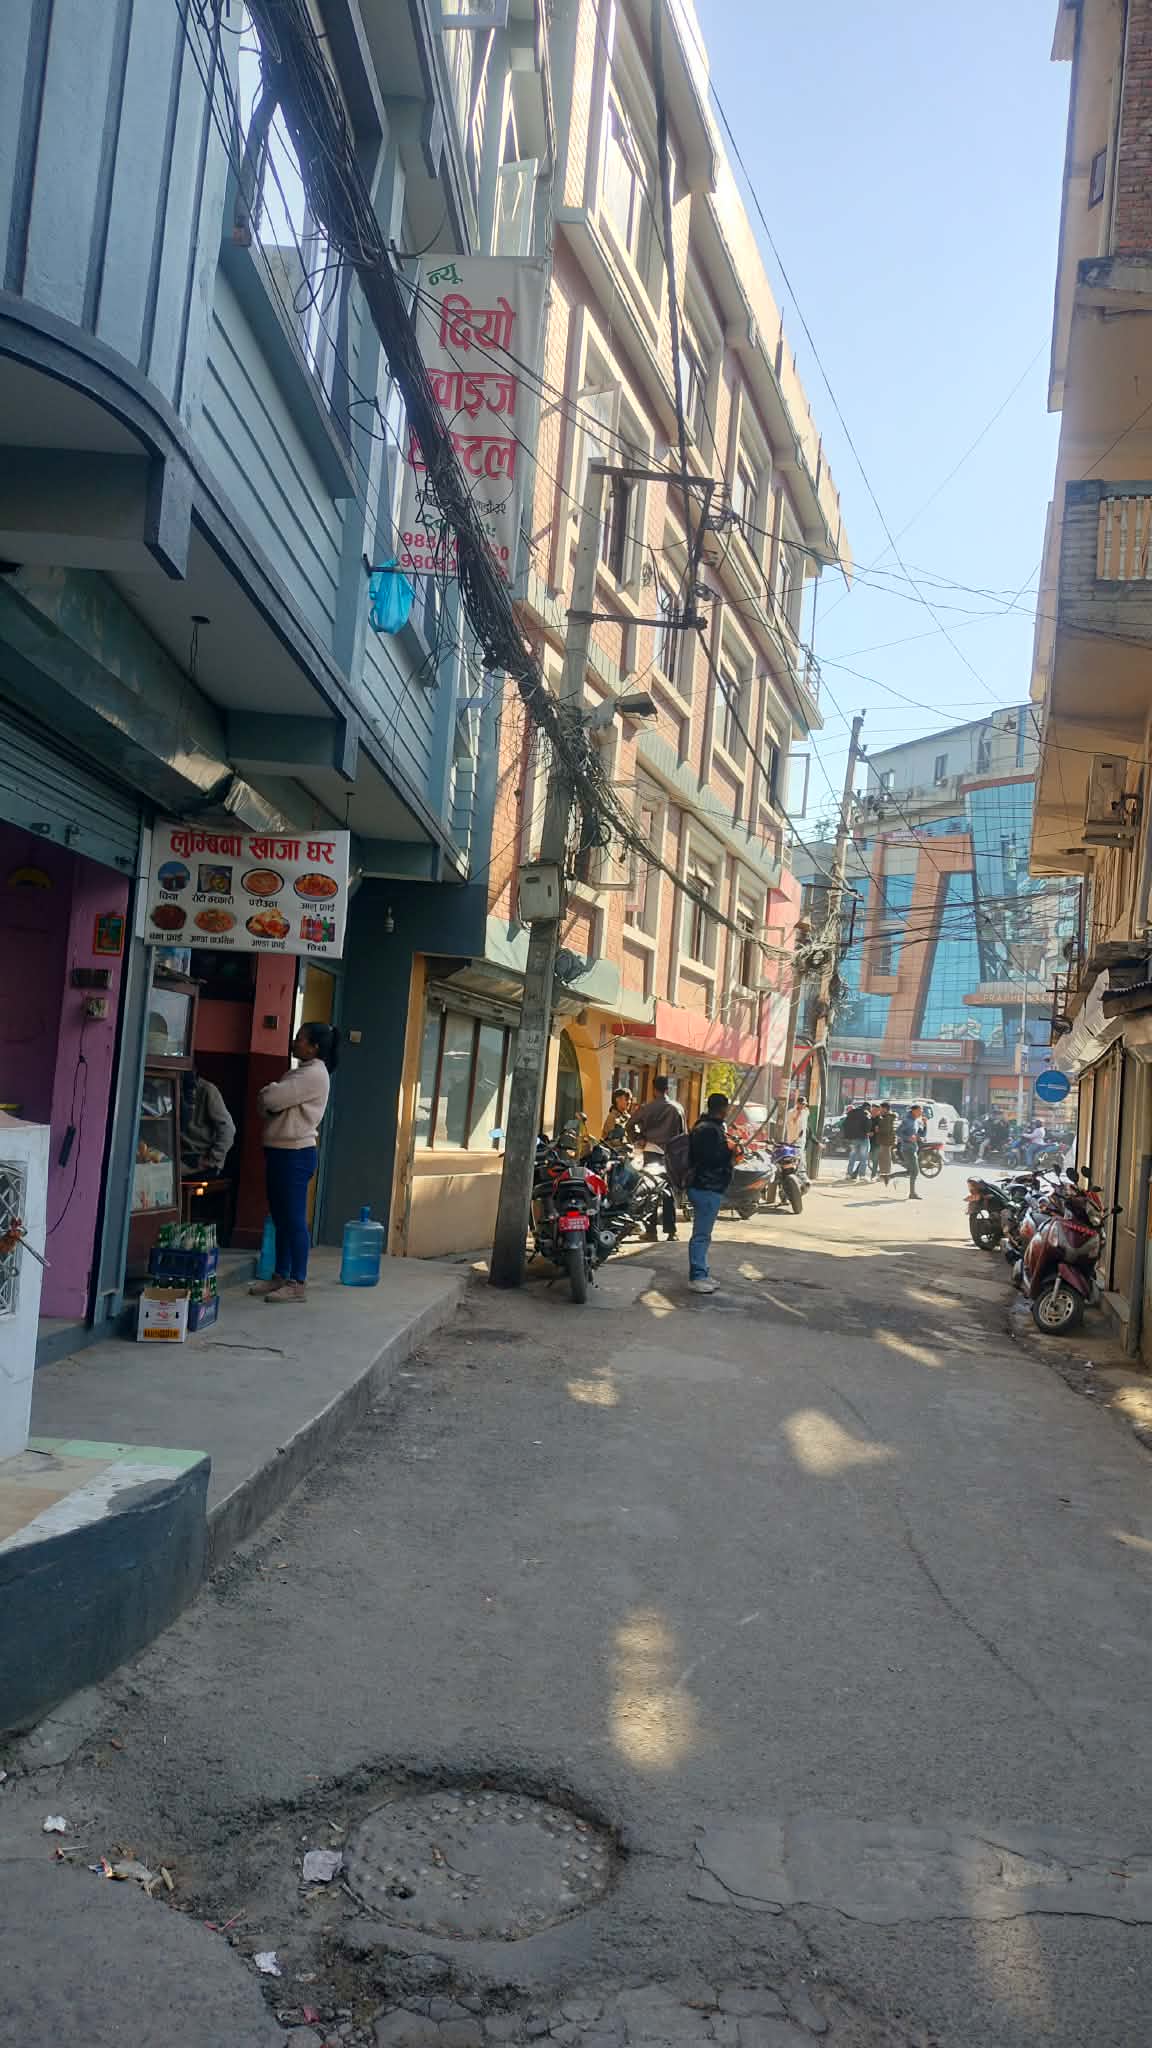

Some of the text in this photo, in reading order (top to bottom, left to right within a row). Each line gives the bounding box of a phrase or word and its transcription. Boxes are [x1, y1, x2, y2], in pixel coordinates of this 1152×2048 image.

[426, 263, 463, 285] न्यू
[439, 293, 517, 352] दियो
[249, 837, 301, 861] खाजा
[306, 841, 337, 864] घर
